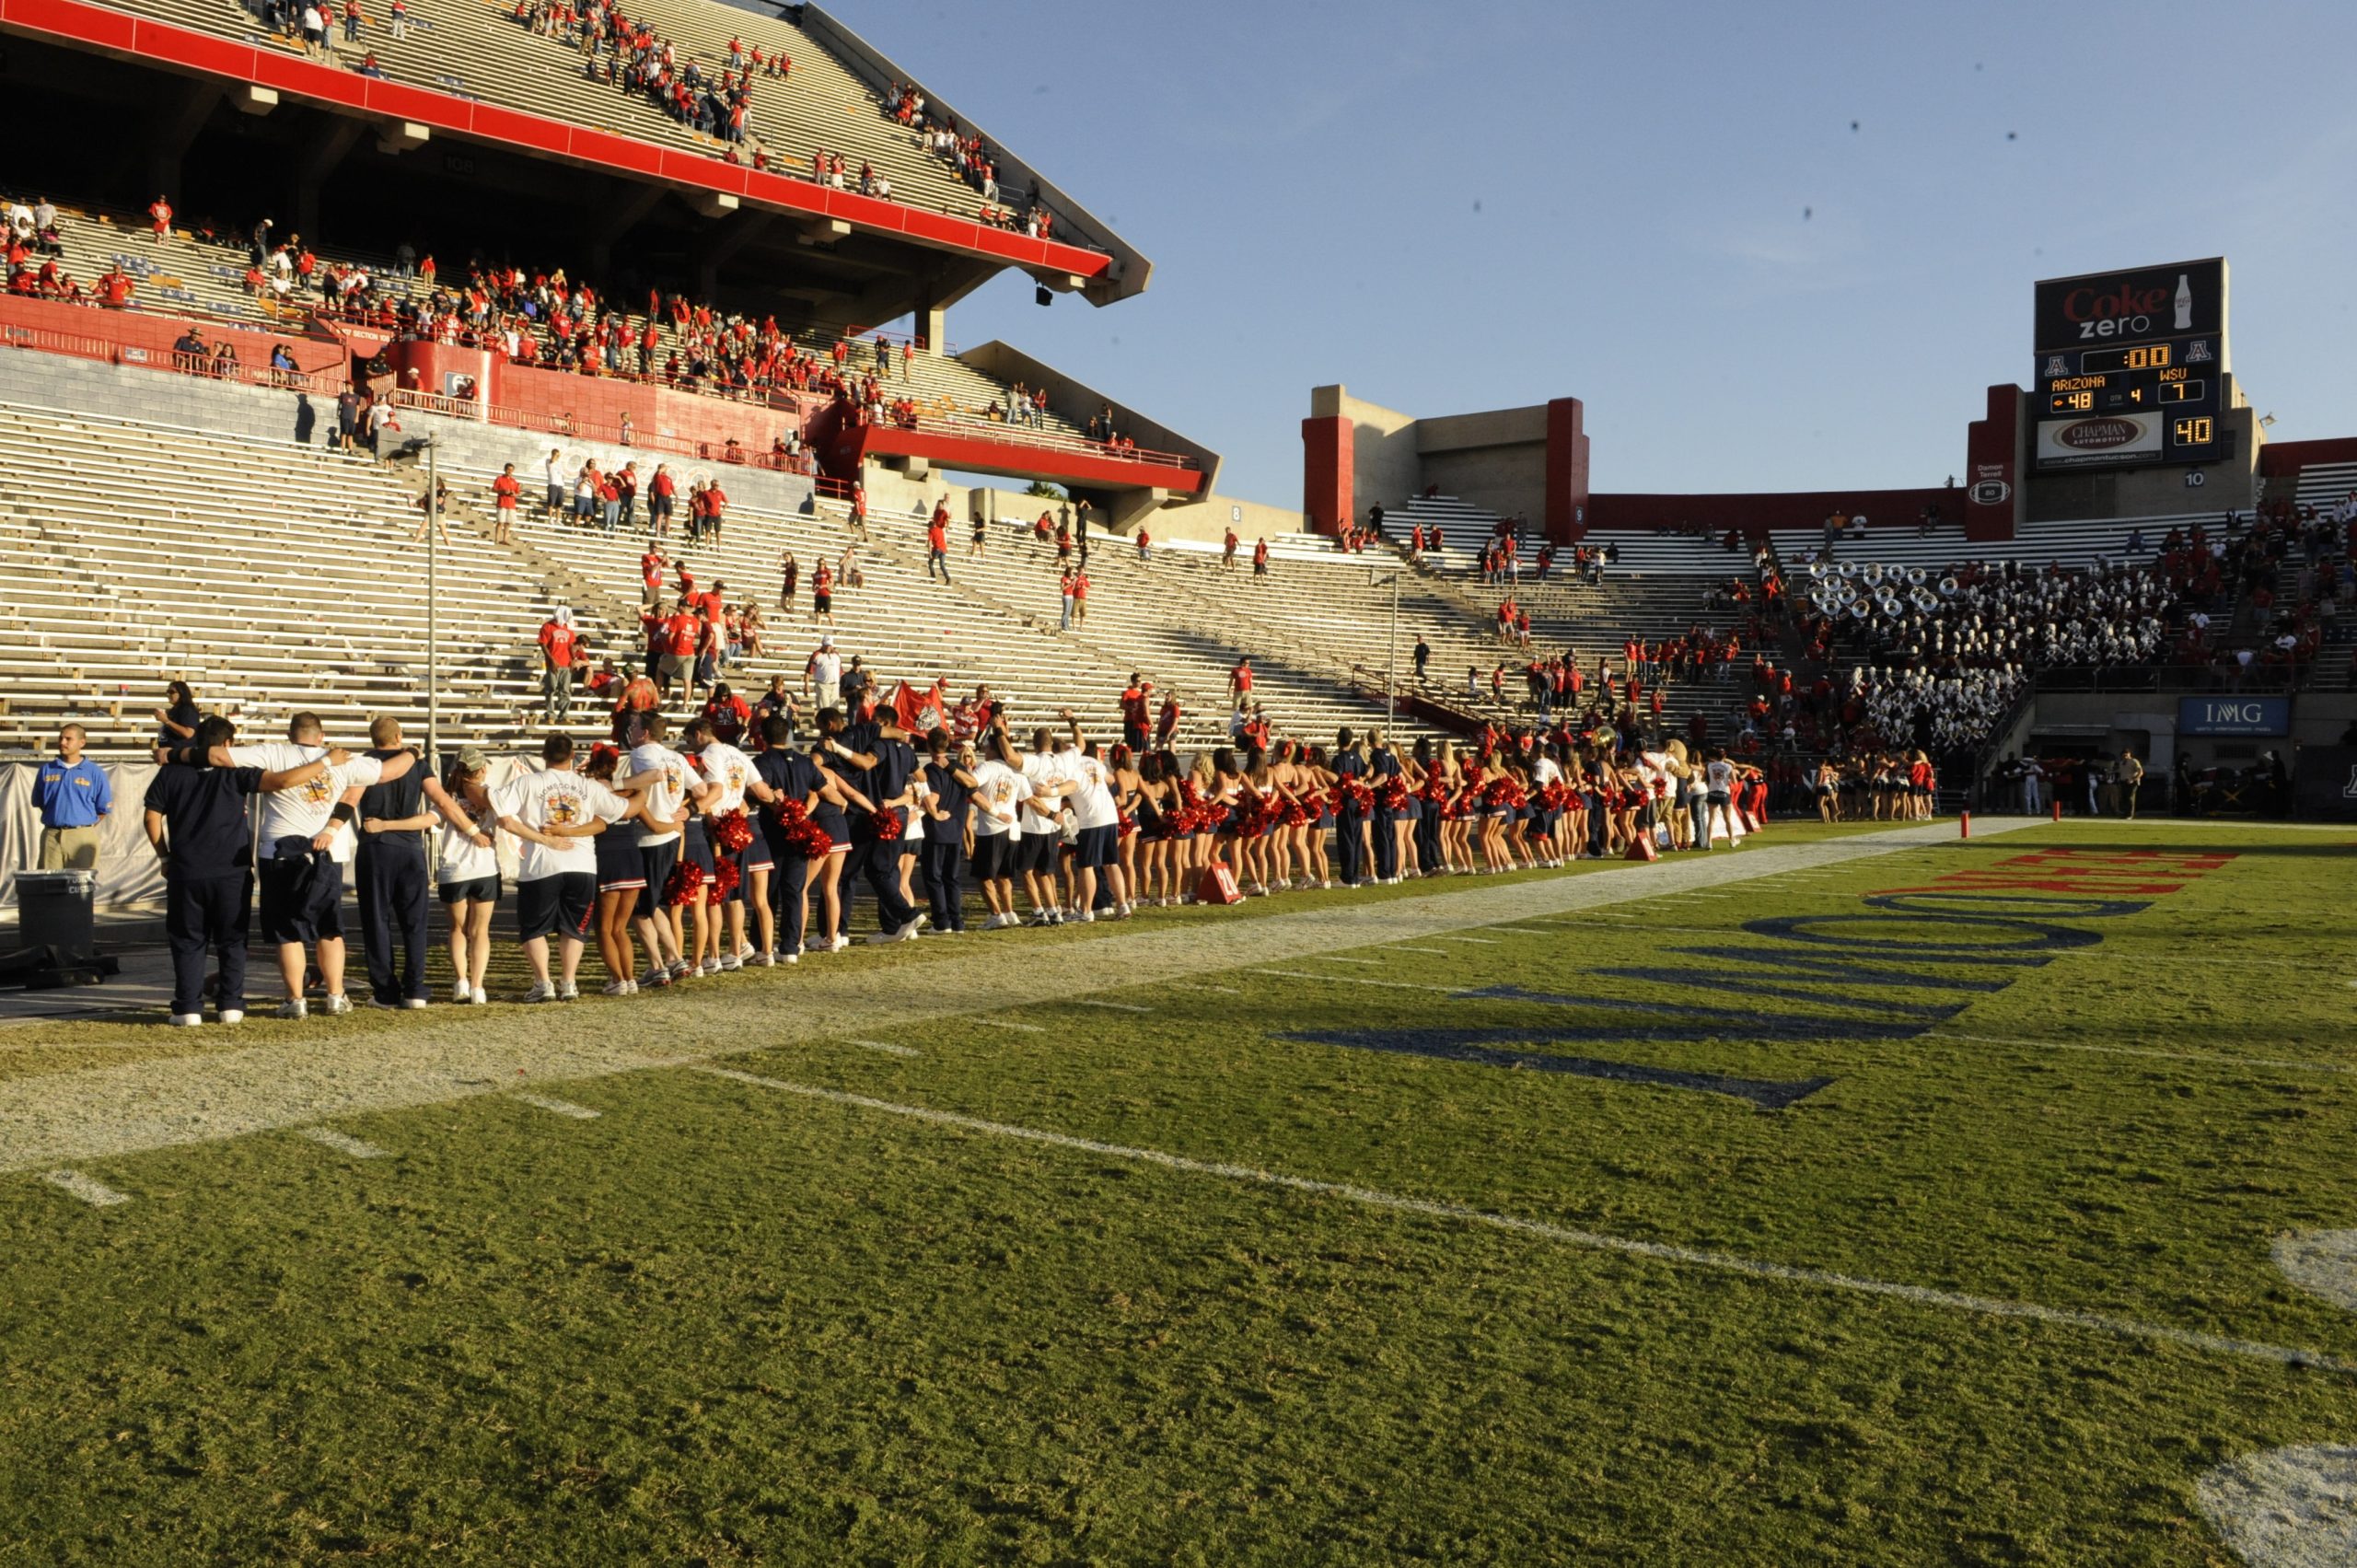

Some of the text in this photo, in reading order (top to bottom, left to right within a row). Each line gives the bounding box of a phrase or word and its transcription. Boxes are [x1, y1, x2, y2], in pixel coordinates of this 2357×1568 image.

[2063, 284, 2167, 322] Coke
[2080, 315, 2150, 339] zero
[353, 330, 378, 341] SECTION
[2186, 341, 2211, 363] A
[2045, 355, 2068, 377] A
[2160, 368, 2187, 381] WSU
[2052, 376, 2106, 391] ARIZONA
[2131, 389, 2141, 402] 4
[2173, 384, 2184, 400] 7
[2068, 393, 2092, 410] 48
[2073, 424, 2126, 438] CHAPMAN
[2177, 419, 2211, 443] 40
[2073, 436, 2126, 445] AUTOMOTIVE
[2044, 452, 2156, 465] www.chapmantucson.com
[2186, 473, 2204, 485] 10
[1233, 506, 1240, 521] 8
[1576, 508, 1582, 521] 9
[2206, 703, 2262, 722] IMG
